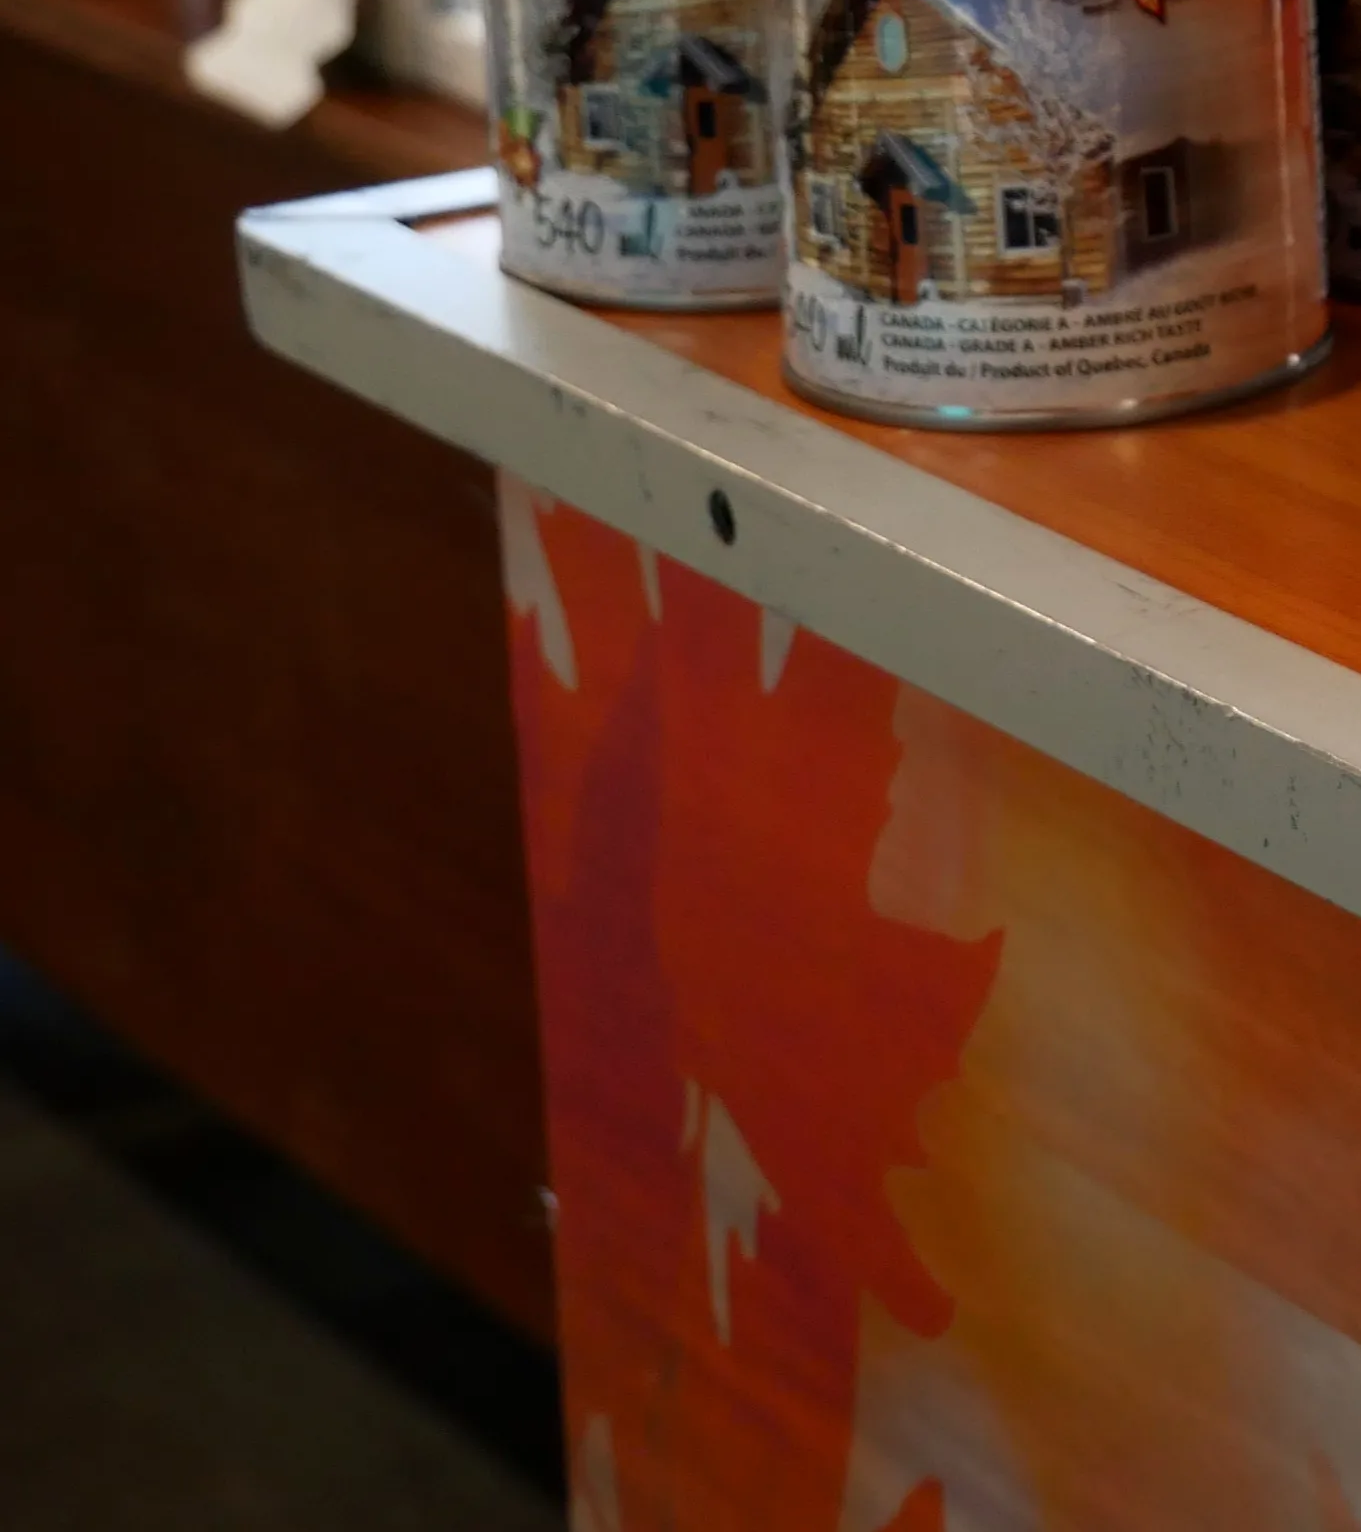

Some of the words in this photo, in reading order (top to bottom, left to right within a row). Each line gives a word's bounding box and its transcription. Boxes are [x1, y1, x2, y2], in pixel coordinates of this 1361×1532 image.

[880, 311, 945, 331] CANADA
[881, 332, 947, 352] CANADA
[960, 337, 1018, 354] GRADE
[881, 354, 943, 378] Produit
[944, 360, 967, 378] du
[980, 361, 1050, 380] Product
[1053, 358, 1073, 377] of
